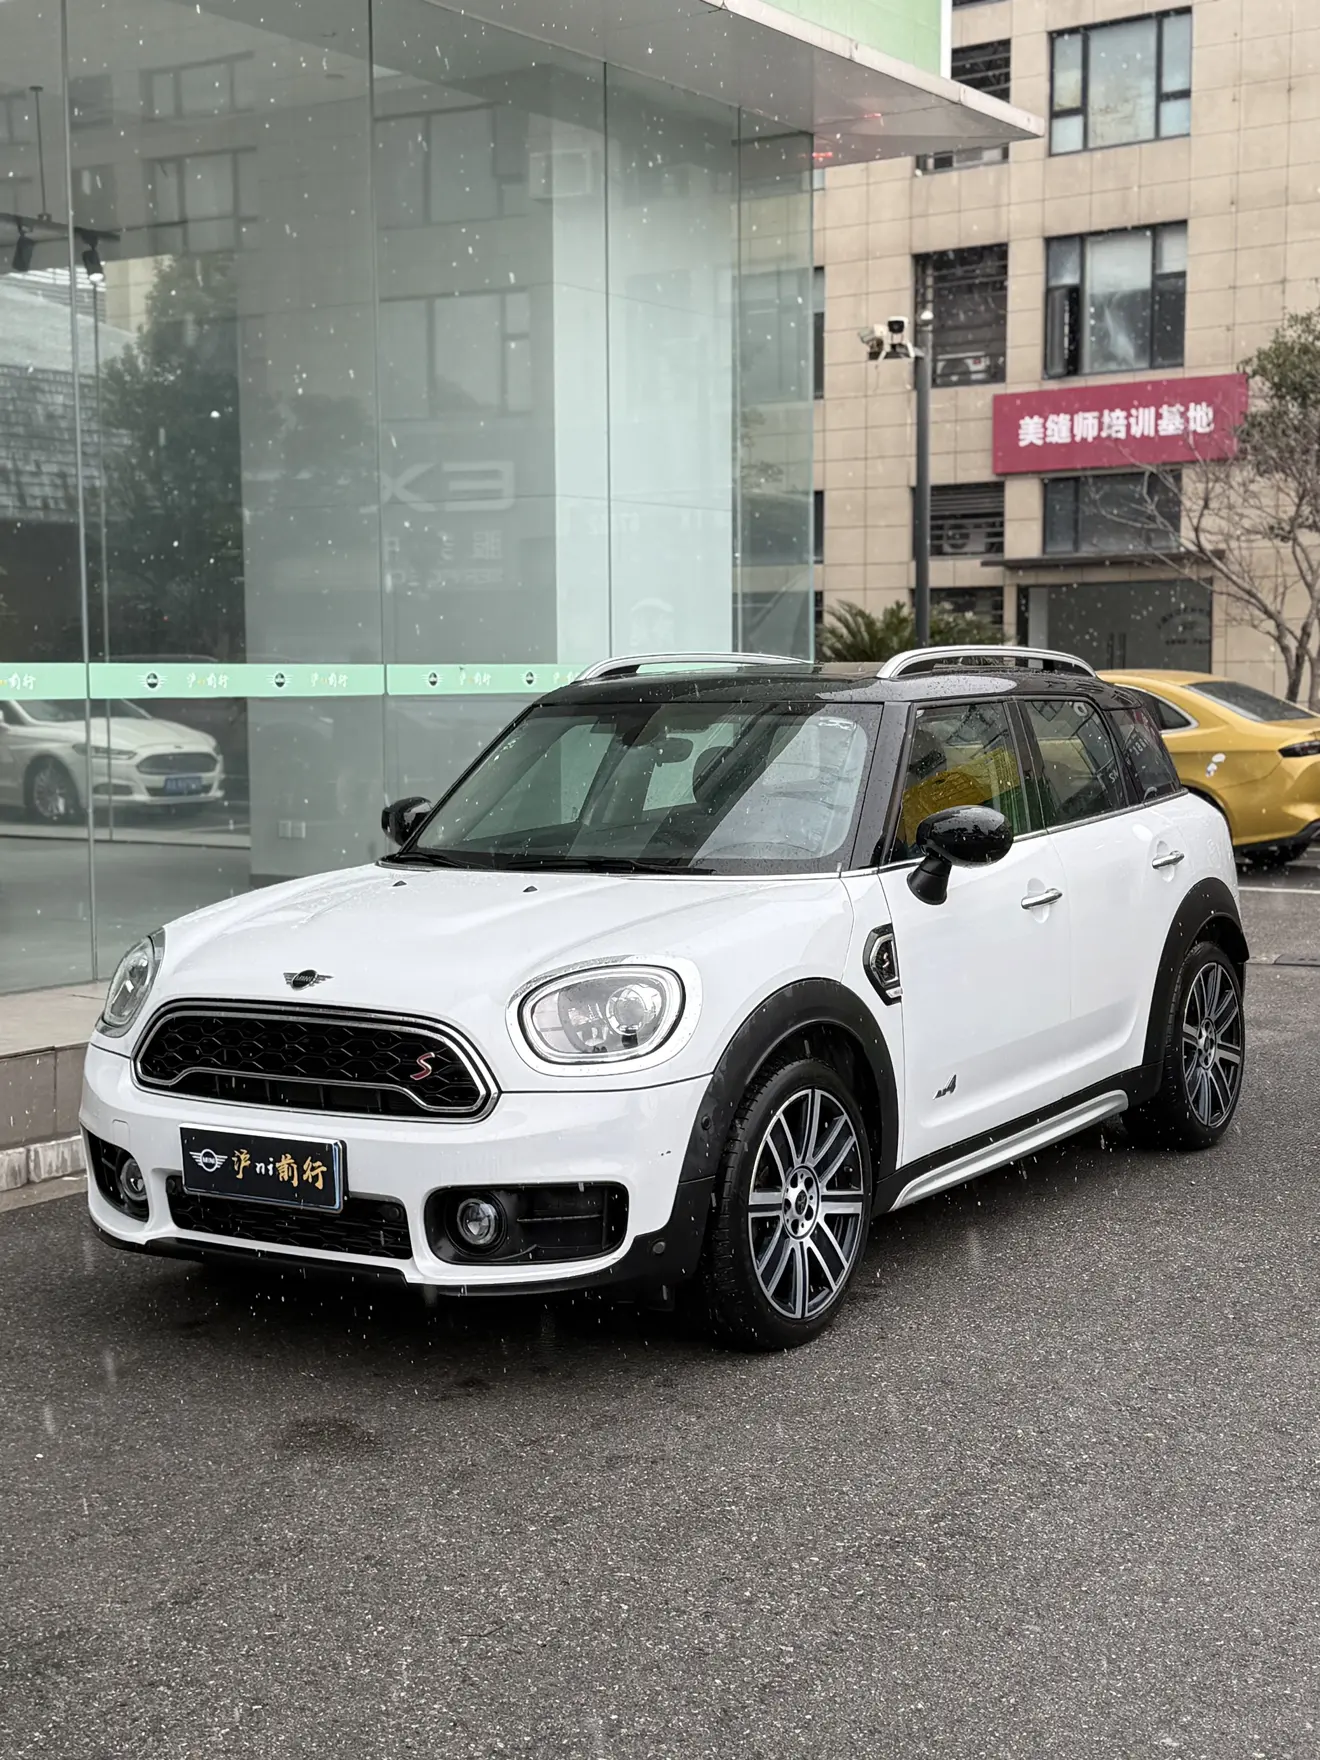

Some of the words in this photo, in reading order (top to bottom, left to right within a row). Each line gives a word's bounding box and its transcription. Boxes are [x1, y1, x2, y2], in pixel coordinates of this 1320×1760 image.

[1017, 402, 1215, 447] 美缝师培训基地
[410, 1052, 435, 1080] S
